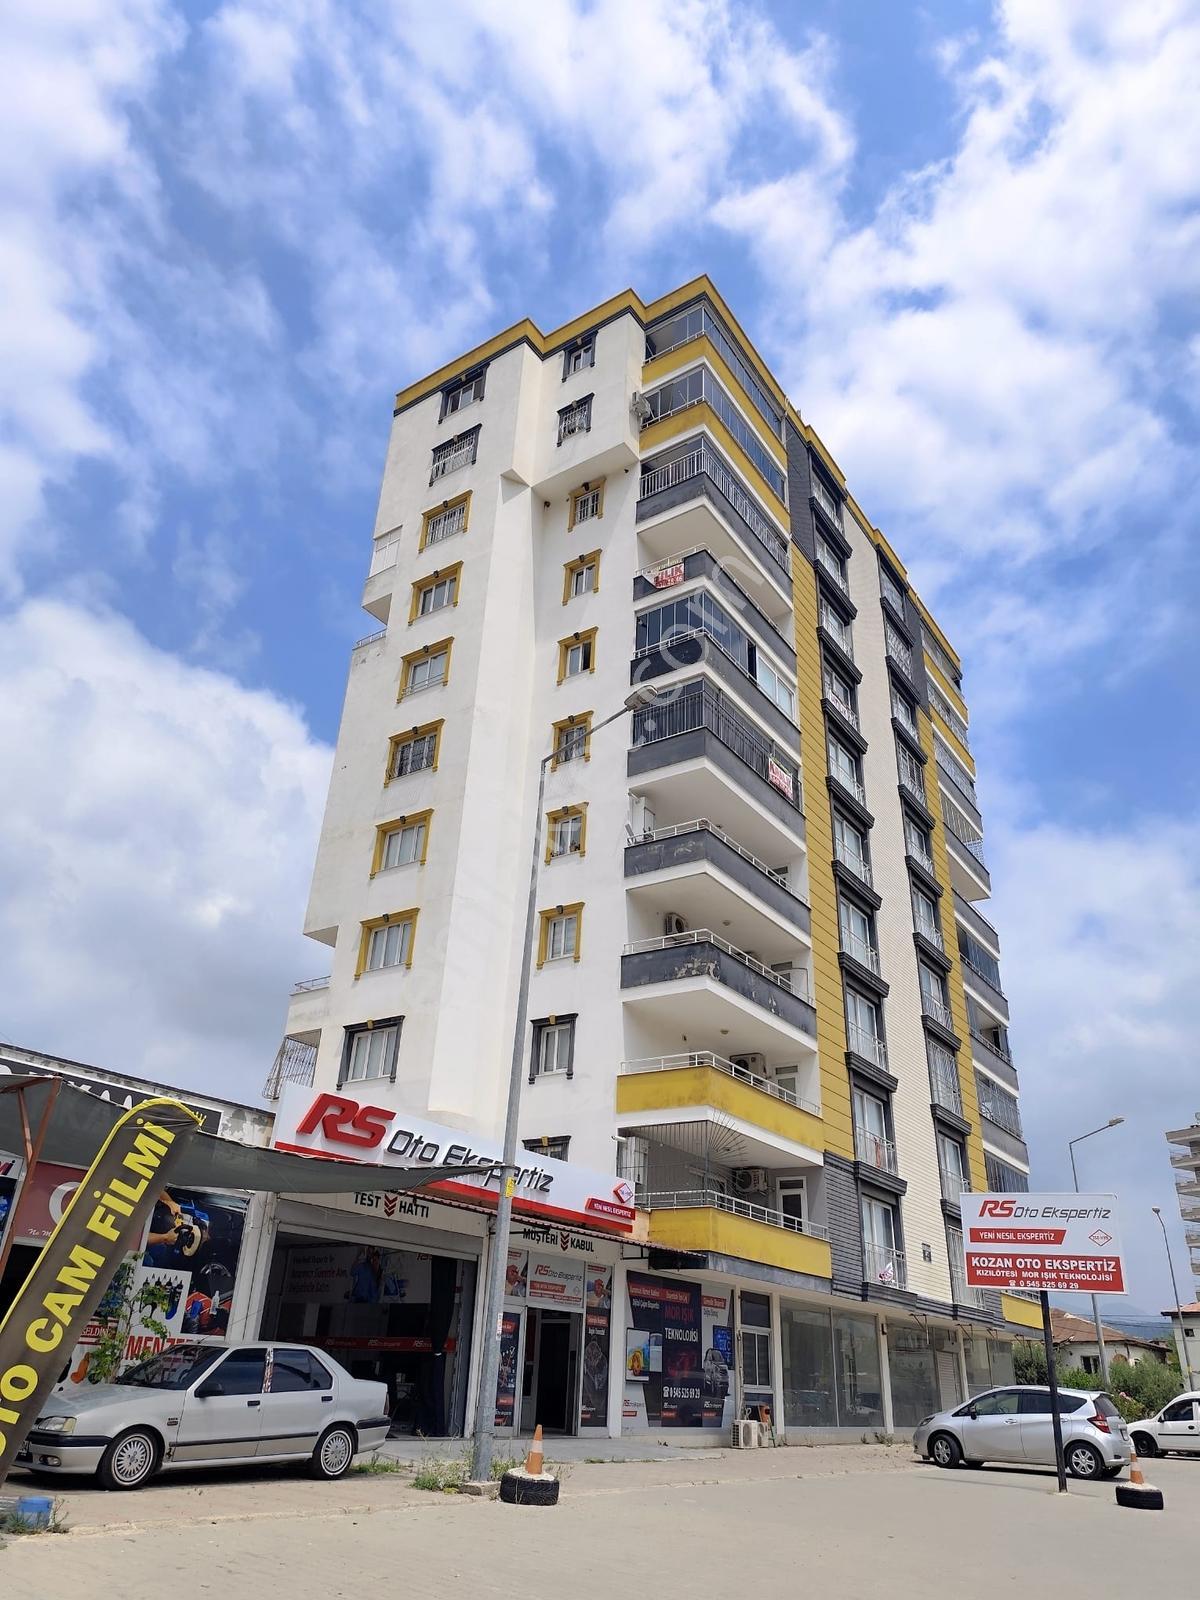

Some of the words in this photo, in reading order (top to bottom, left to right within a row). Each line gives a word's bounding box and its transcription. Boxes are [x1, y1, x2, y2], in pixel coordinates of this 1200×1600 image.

[296, 1093, 397, 1148] RS
[387, 1130, 440, 1162] Oto
[354, 1191, 381, 1208] TEST
[398, 1201, 429, 1218] HATTI
[978, 1200, 1016, 1217] RS
[1013, 1206, 1039, 1218] Oto
[1041, 1207, 1111, 1223] Ekspertiz
[25, 1244, 106, 1353] CAM
[86, 1118, 176, 1242] FİLMİ
[522, 1228, 558, 1245] MÜŞTERİ
[570, 1238, 594, 1252] KABUL
[979, 1230, 995, 1239] YENİ
[996, 1231, 1016, 1240] NESİL
[1017, 1232, 1055, 1241] EKSPERTİZ
[534, 1263, 550, 1276] RS
[971, 1256, 1013, 1268] KOZAN
[1016, 1258, 1041, 1269] OTO
[1045, 1258, 1117, 1272] EKSPERTİZ
[1021, 1271, 1039, 1279] MOR
[1041, 1272, 1058, 1281] IŞIK
[1059, 1272, 1113, 1282] TEKNOLOJİSİ
[1026, 1280, 1040, 1288] 545
[664, 1327, 699, 1343] TEKNOLOJİSİ
